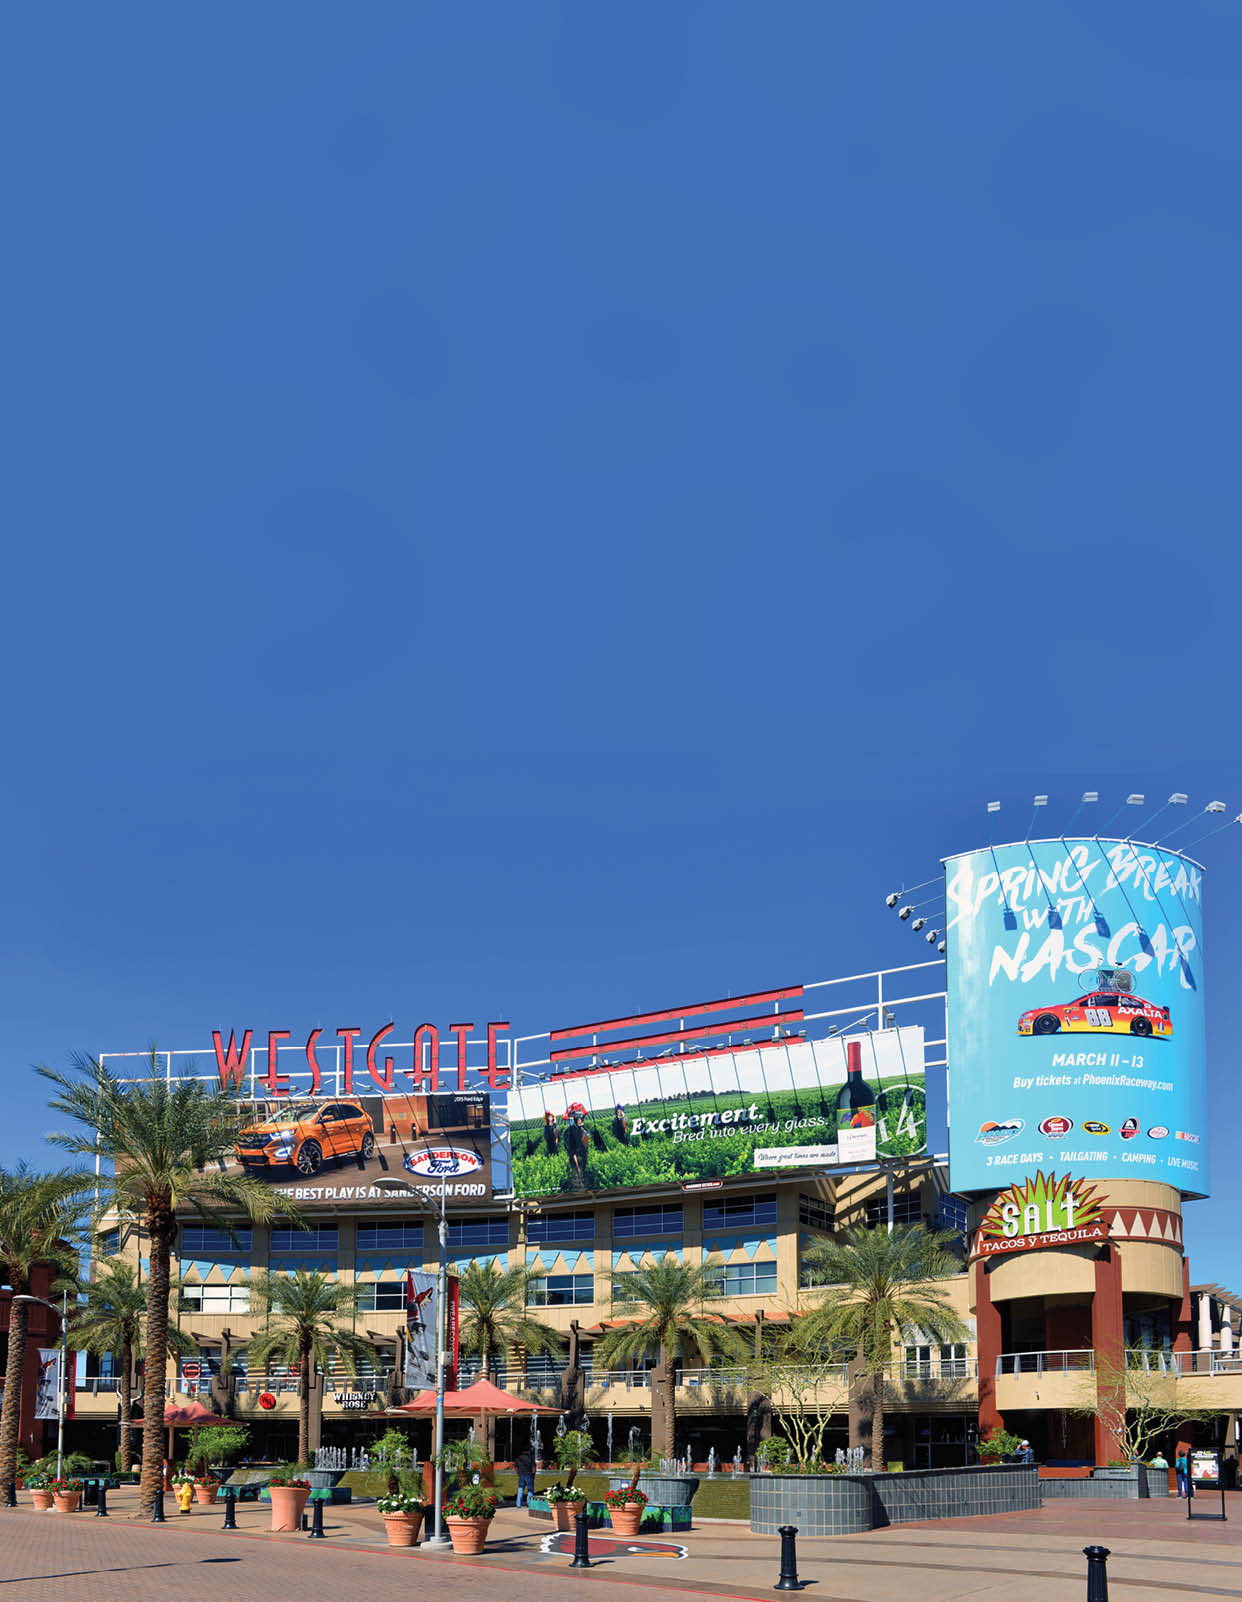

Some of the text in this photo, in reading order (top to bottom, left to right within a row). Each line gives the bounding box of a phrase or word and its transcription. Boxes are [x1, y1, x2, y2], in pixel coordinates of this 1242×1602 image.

[946, 843, 1202, 929] SPRING BREAK
[1024, 895, 1094, 929] WITH
[989, 922, 1196, 988] NASCAR
[1084, 1008, 1113, 1027] 88
[1118, 1007, 1163, 1019] AXALTA
[212, 1022, 511, 1096] WESTGATE
[1052, 1053, 1107, 1066] MARCH
[1013, 1077, 1033, 1089] Buy
[1036, 1074, 1071, 1086] tickets
[1082, 1074, 1174, 1092] PhoenixRaceway.com
[630, 1103, 763, 1135] Excitement.
[673, 1115, 829, 1143] Bred into every glass.
[410, 1151, 477, 1167] SANDERSON
[427, 1160, 459, 1174] Ford
[986, 1156, 993, 1167] 3
[994, 1154, 1019, 1165] RACE
[1020, 1152, 1043, 1163] DAYS
[1060, 1151, 1108, 1161] TAILGATING
[1121, 1152, 1156, 1165] CAMPING
[1167, 1157, 1181, 1167] LIVE
[296, 1187, 324, 1200] BEST
[325, 1186, 354, 1199] PLAY
[355, 1186, 366, 1199] IS
[368, 1185, 381, 1198] AT
[455, 1183, 486, 1196] FORD
[983, 1237, 1025, 1252] TACOS
[1040, 1227, 1103, 1244] TEQUILA
[332, 1392, 376, 1401] WHISKEY
[342, 1400, 367, 1409] ROSE
